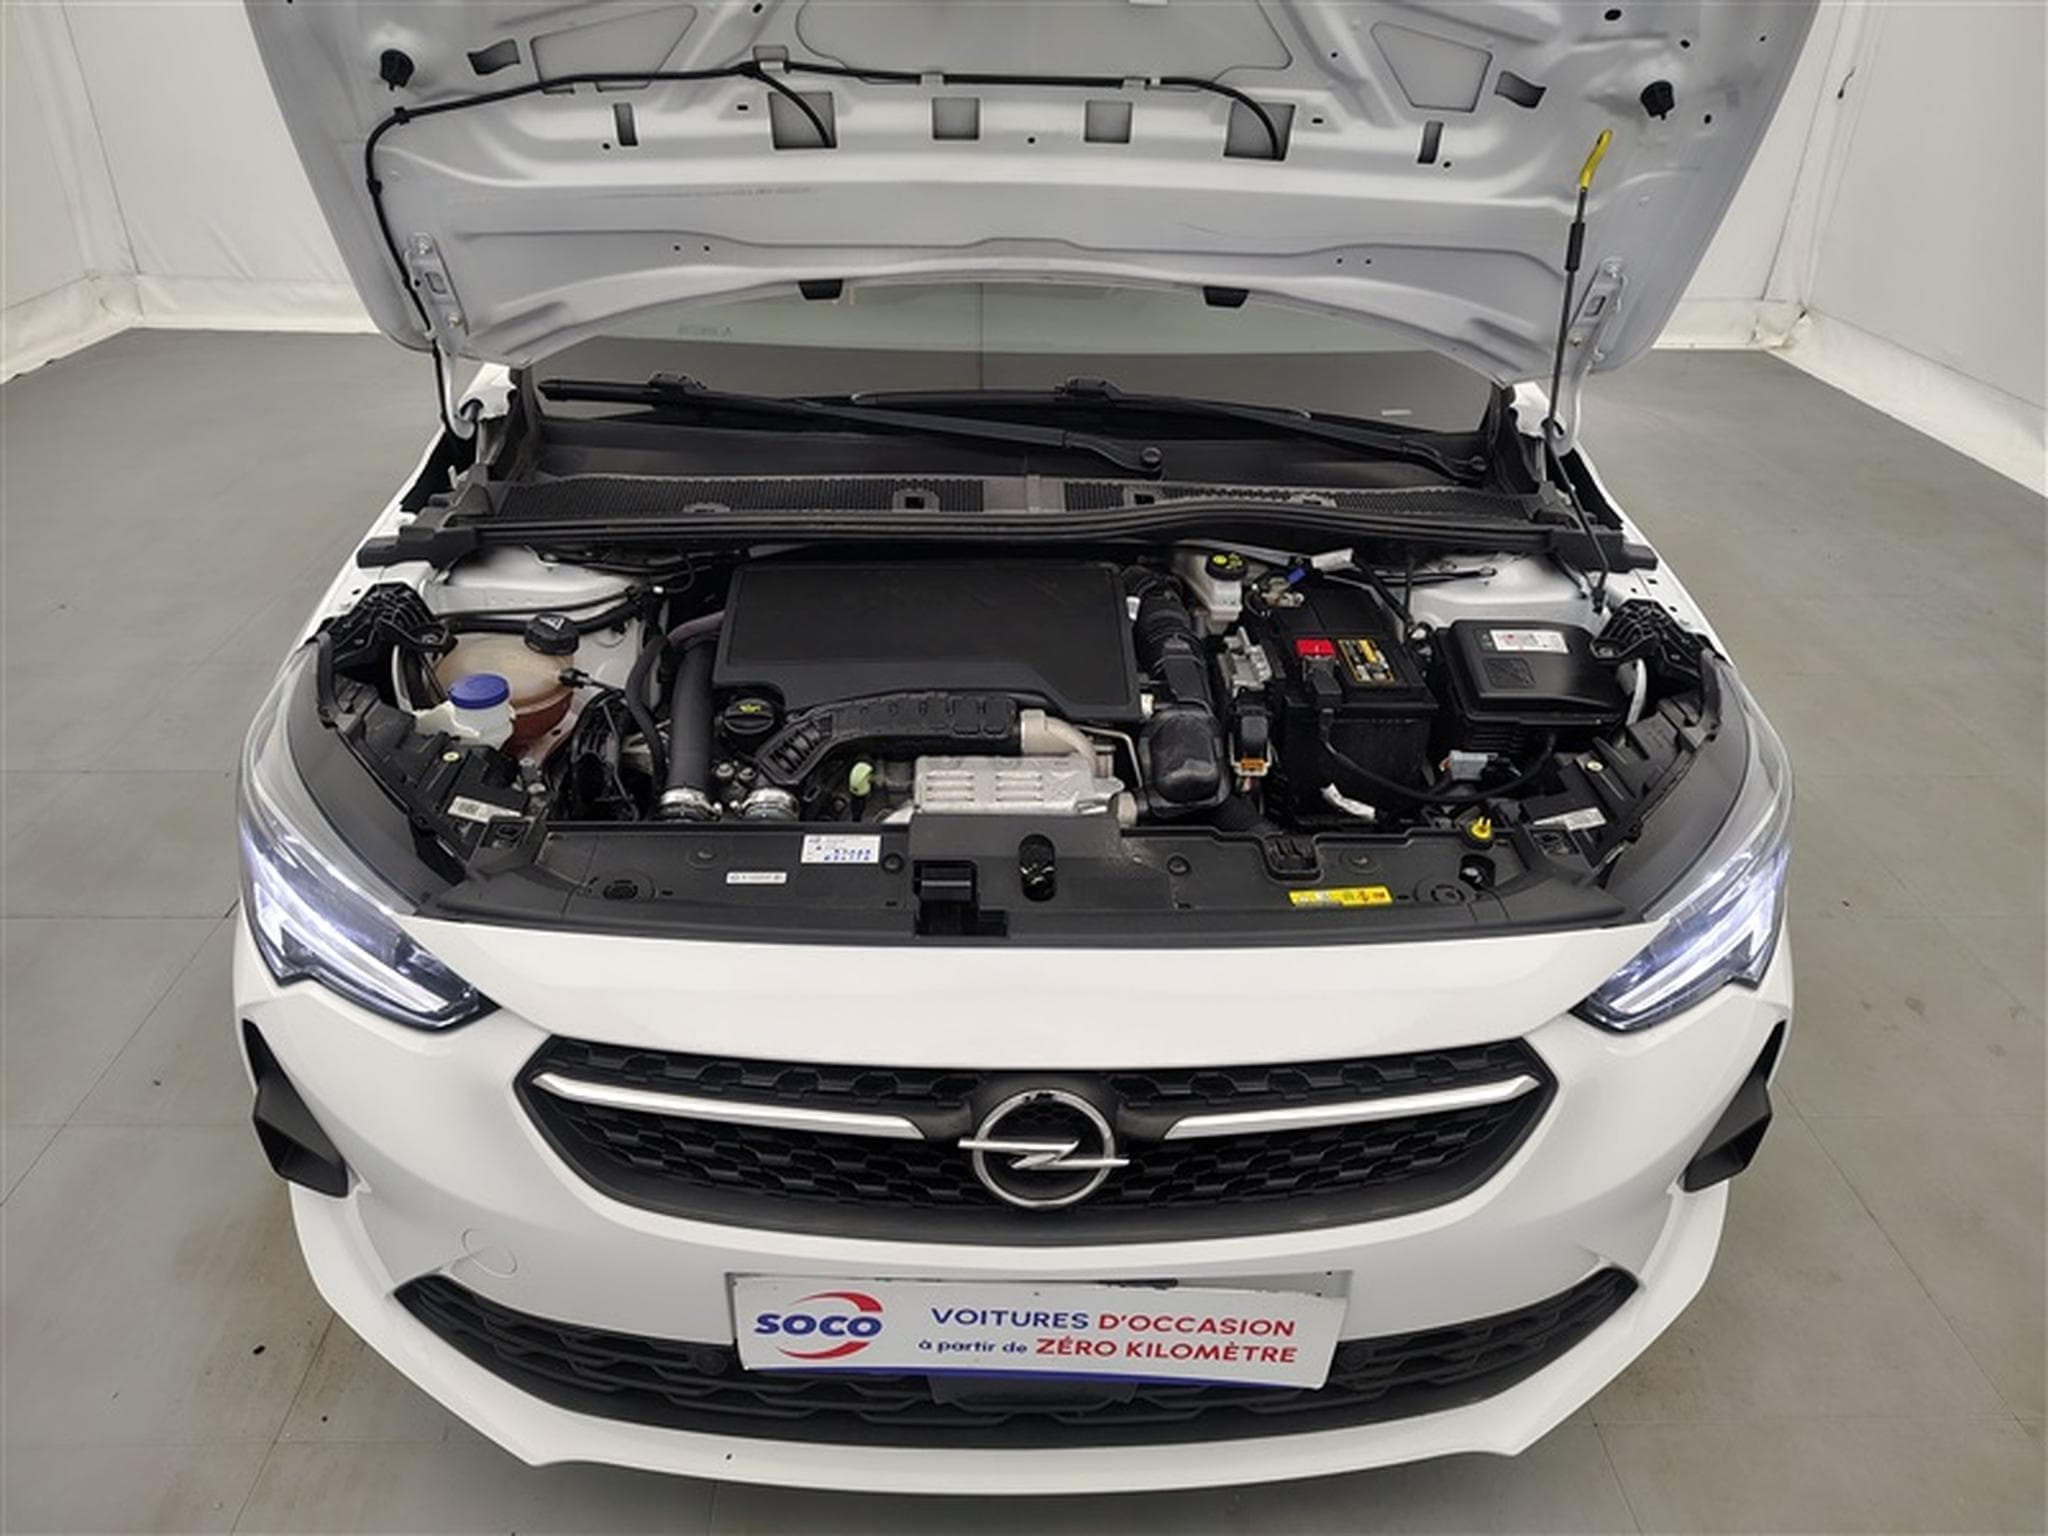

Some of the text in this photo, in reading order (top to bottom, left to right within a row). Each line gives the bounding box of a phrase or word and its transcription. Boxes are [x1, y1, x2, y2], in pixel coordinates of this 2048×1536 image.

[753, 1312, 883, 1338] SOCO
[931, 1307, 1296, 1337] VOITURES D'OCCASION
[918, 1335, 1298, 1363] à partir de ZÉRO KILOMÈTRE
